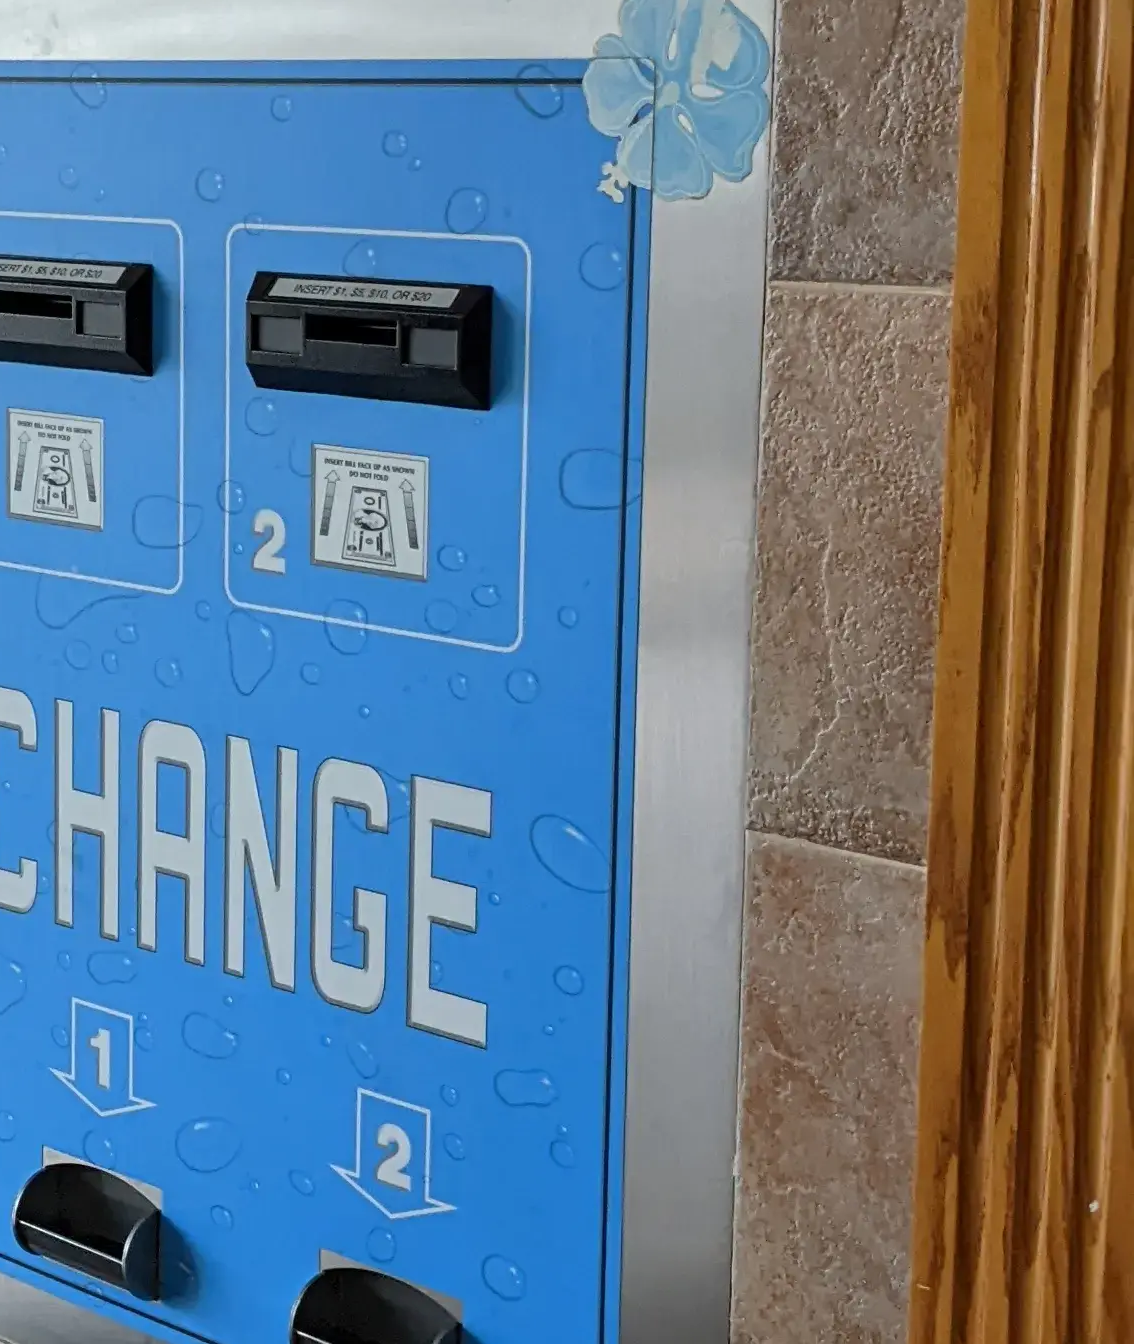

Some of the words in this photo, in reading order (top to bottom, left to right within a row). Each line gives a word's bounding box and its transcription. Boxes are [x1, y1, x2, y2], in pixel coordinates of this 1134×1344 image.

[294, 284, 334, 296] INSERT
[392, 289, 411, 301] OR
[411, 290, 432, 303] $20
[253, 509, 286, 575] 2
[89, 1028, 112, 1090] 1
[376, 1122, 412, 1192] 2
